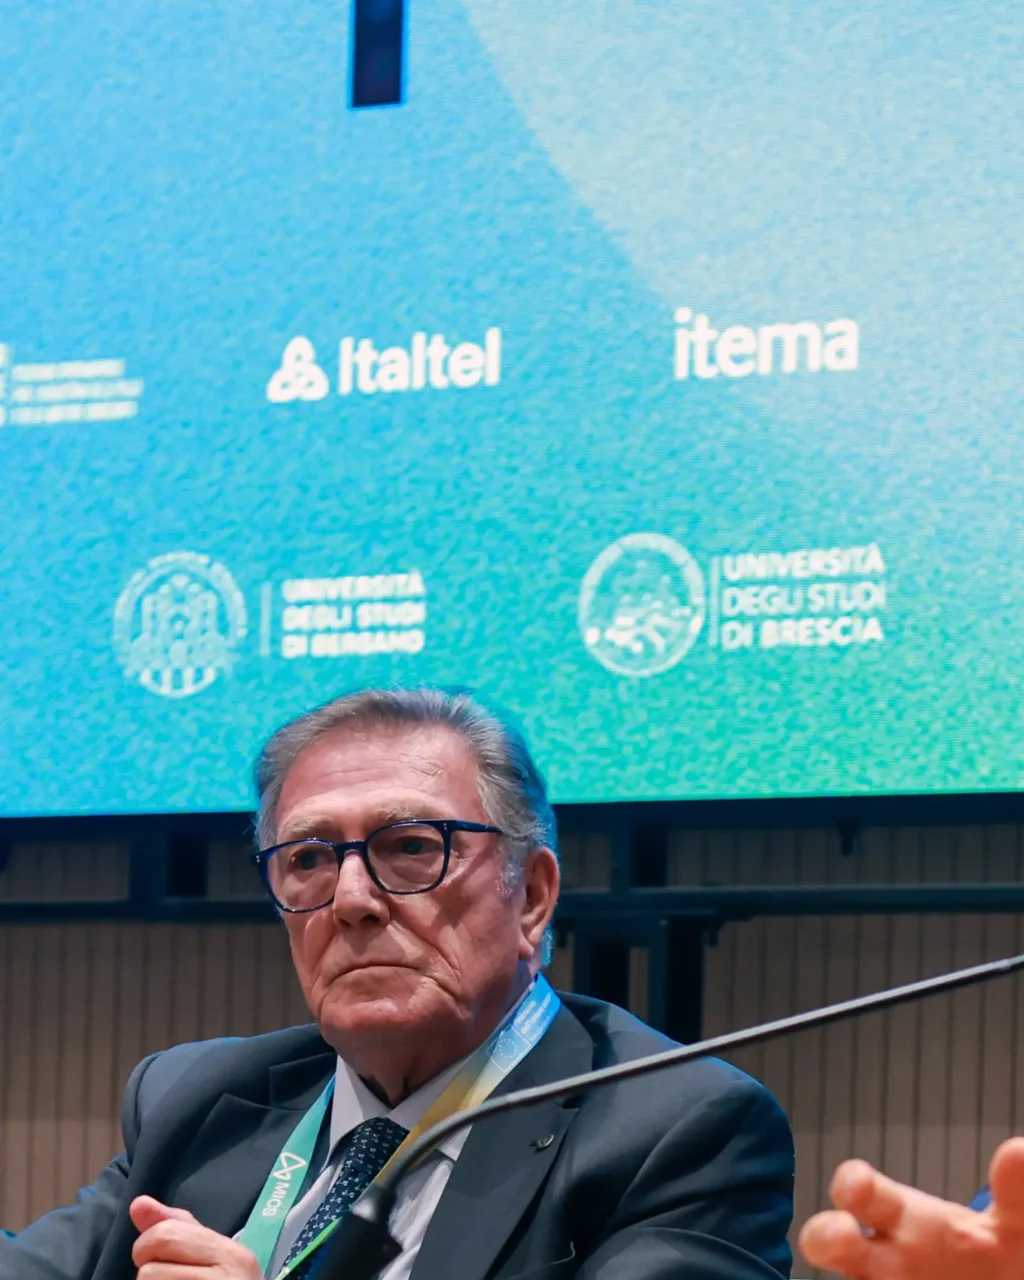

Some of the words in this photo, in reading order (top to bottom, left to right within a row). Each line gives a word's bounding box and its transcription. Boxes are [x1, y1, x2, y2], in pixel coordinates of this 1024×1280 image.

[338, 327, 502, 395] Italtel
[674, 306, 861, 380] itema
[722, 585, 802, 616] DEGLI
[806, 580, 887, 613] STUDI
[721, 620, 754, 650] DI
[760, 616, 886, 648] BRESCIA
[262, 1181, 291, 1217] MICS
